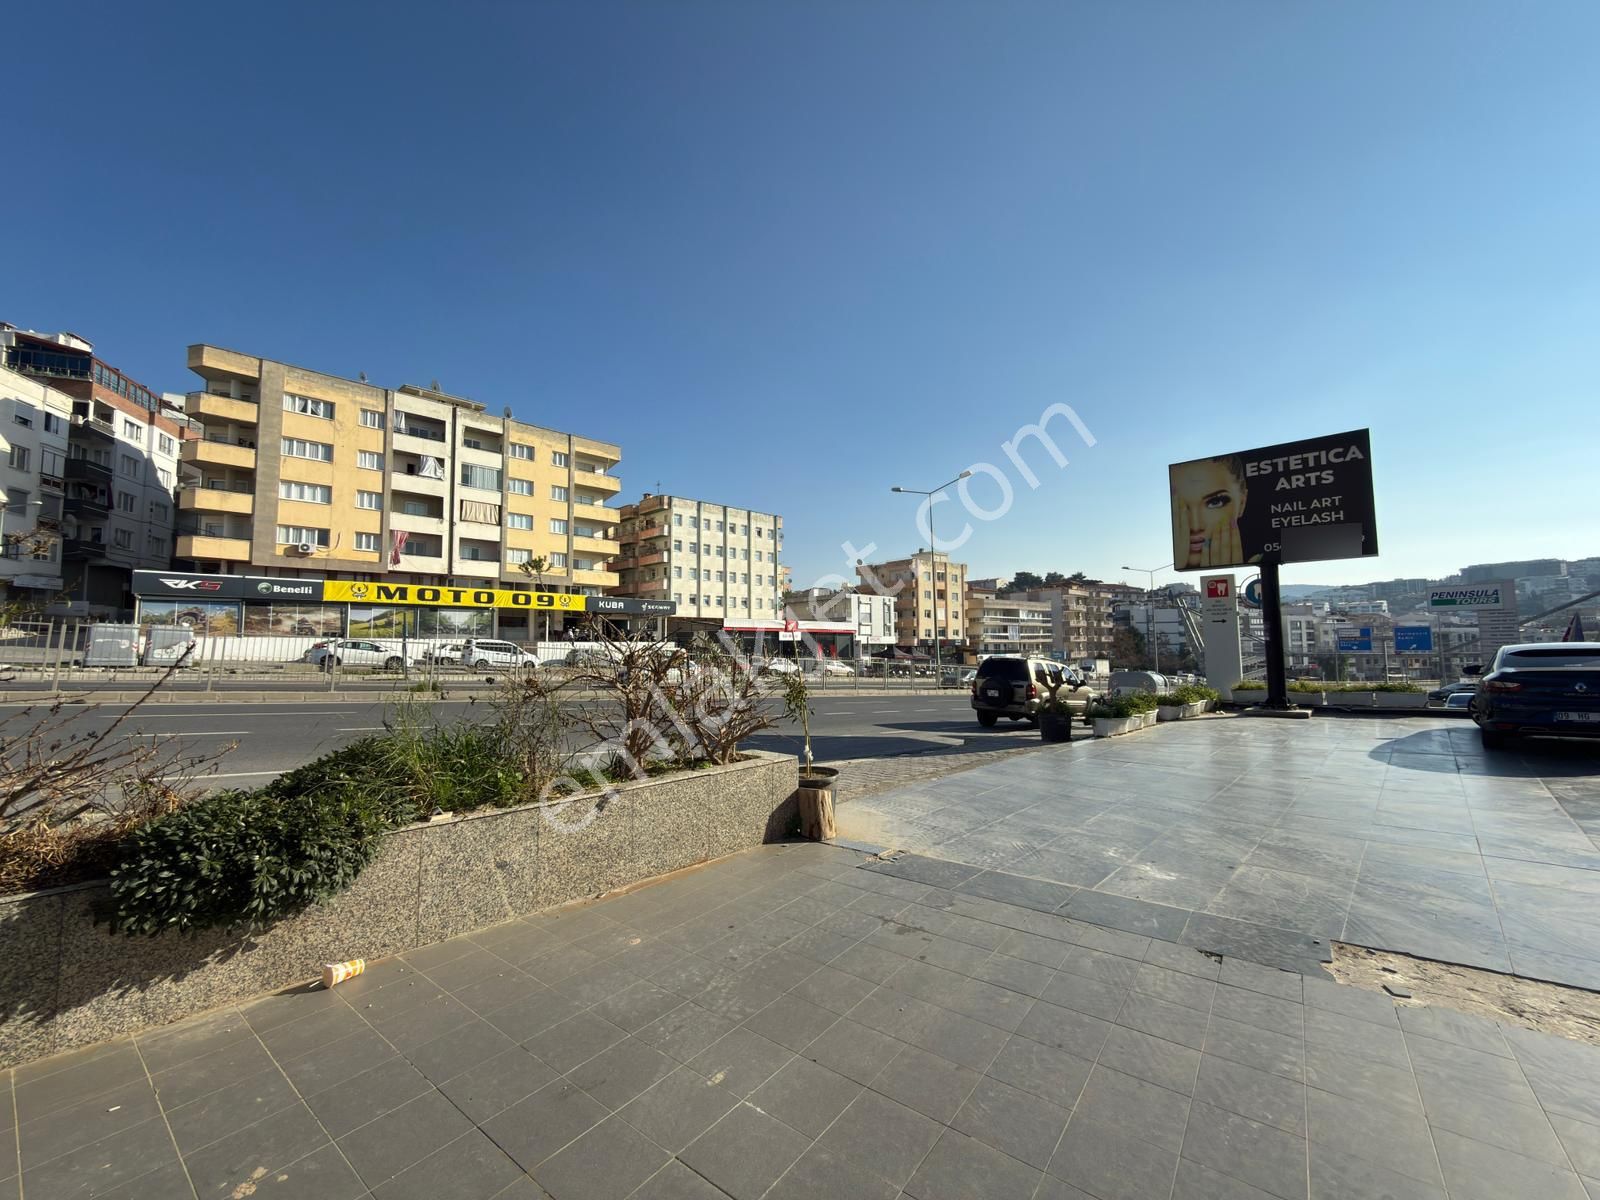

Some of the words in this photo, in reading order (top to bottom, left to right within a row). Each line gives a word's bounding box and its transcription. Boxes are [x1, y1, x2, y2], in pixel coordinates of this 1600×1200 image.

[1245, 445, 1364, 477] ESTETICA
[1274, 470, 1335, 491] ARTS
[1270, 501, 1307, 514] NAIL
[1310, 496, 1343, 509] ART
[1271, 510, 1344, 528] EYELASH
[1264, 542, 1282, 552] 05
[273, 585, 313, 594] Benelli
[376, 585, 495, 605] MOTO
[511, 593, 555, 607] 09
[1431, 589, 1499, 599] PENINSULA
[598, 601, 624, 609] KUBA
[1456, 597, 1497, 605] TOURS
